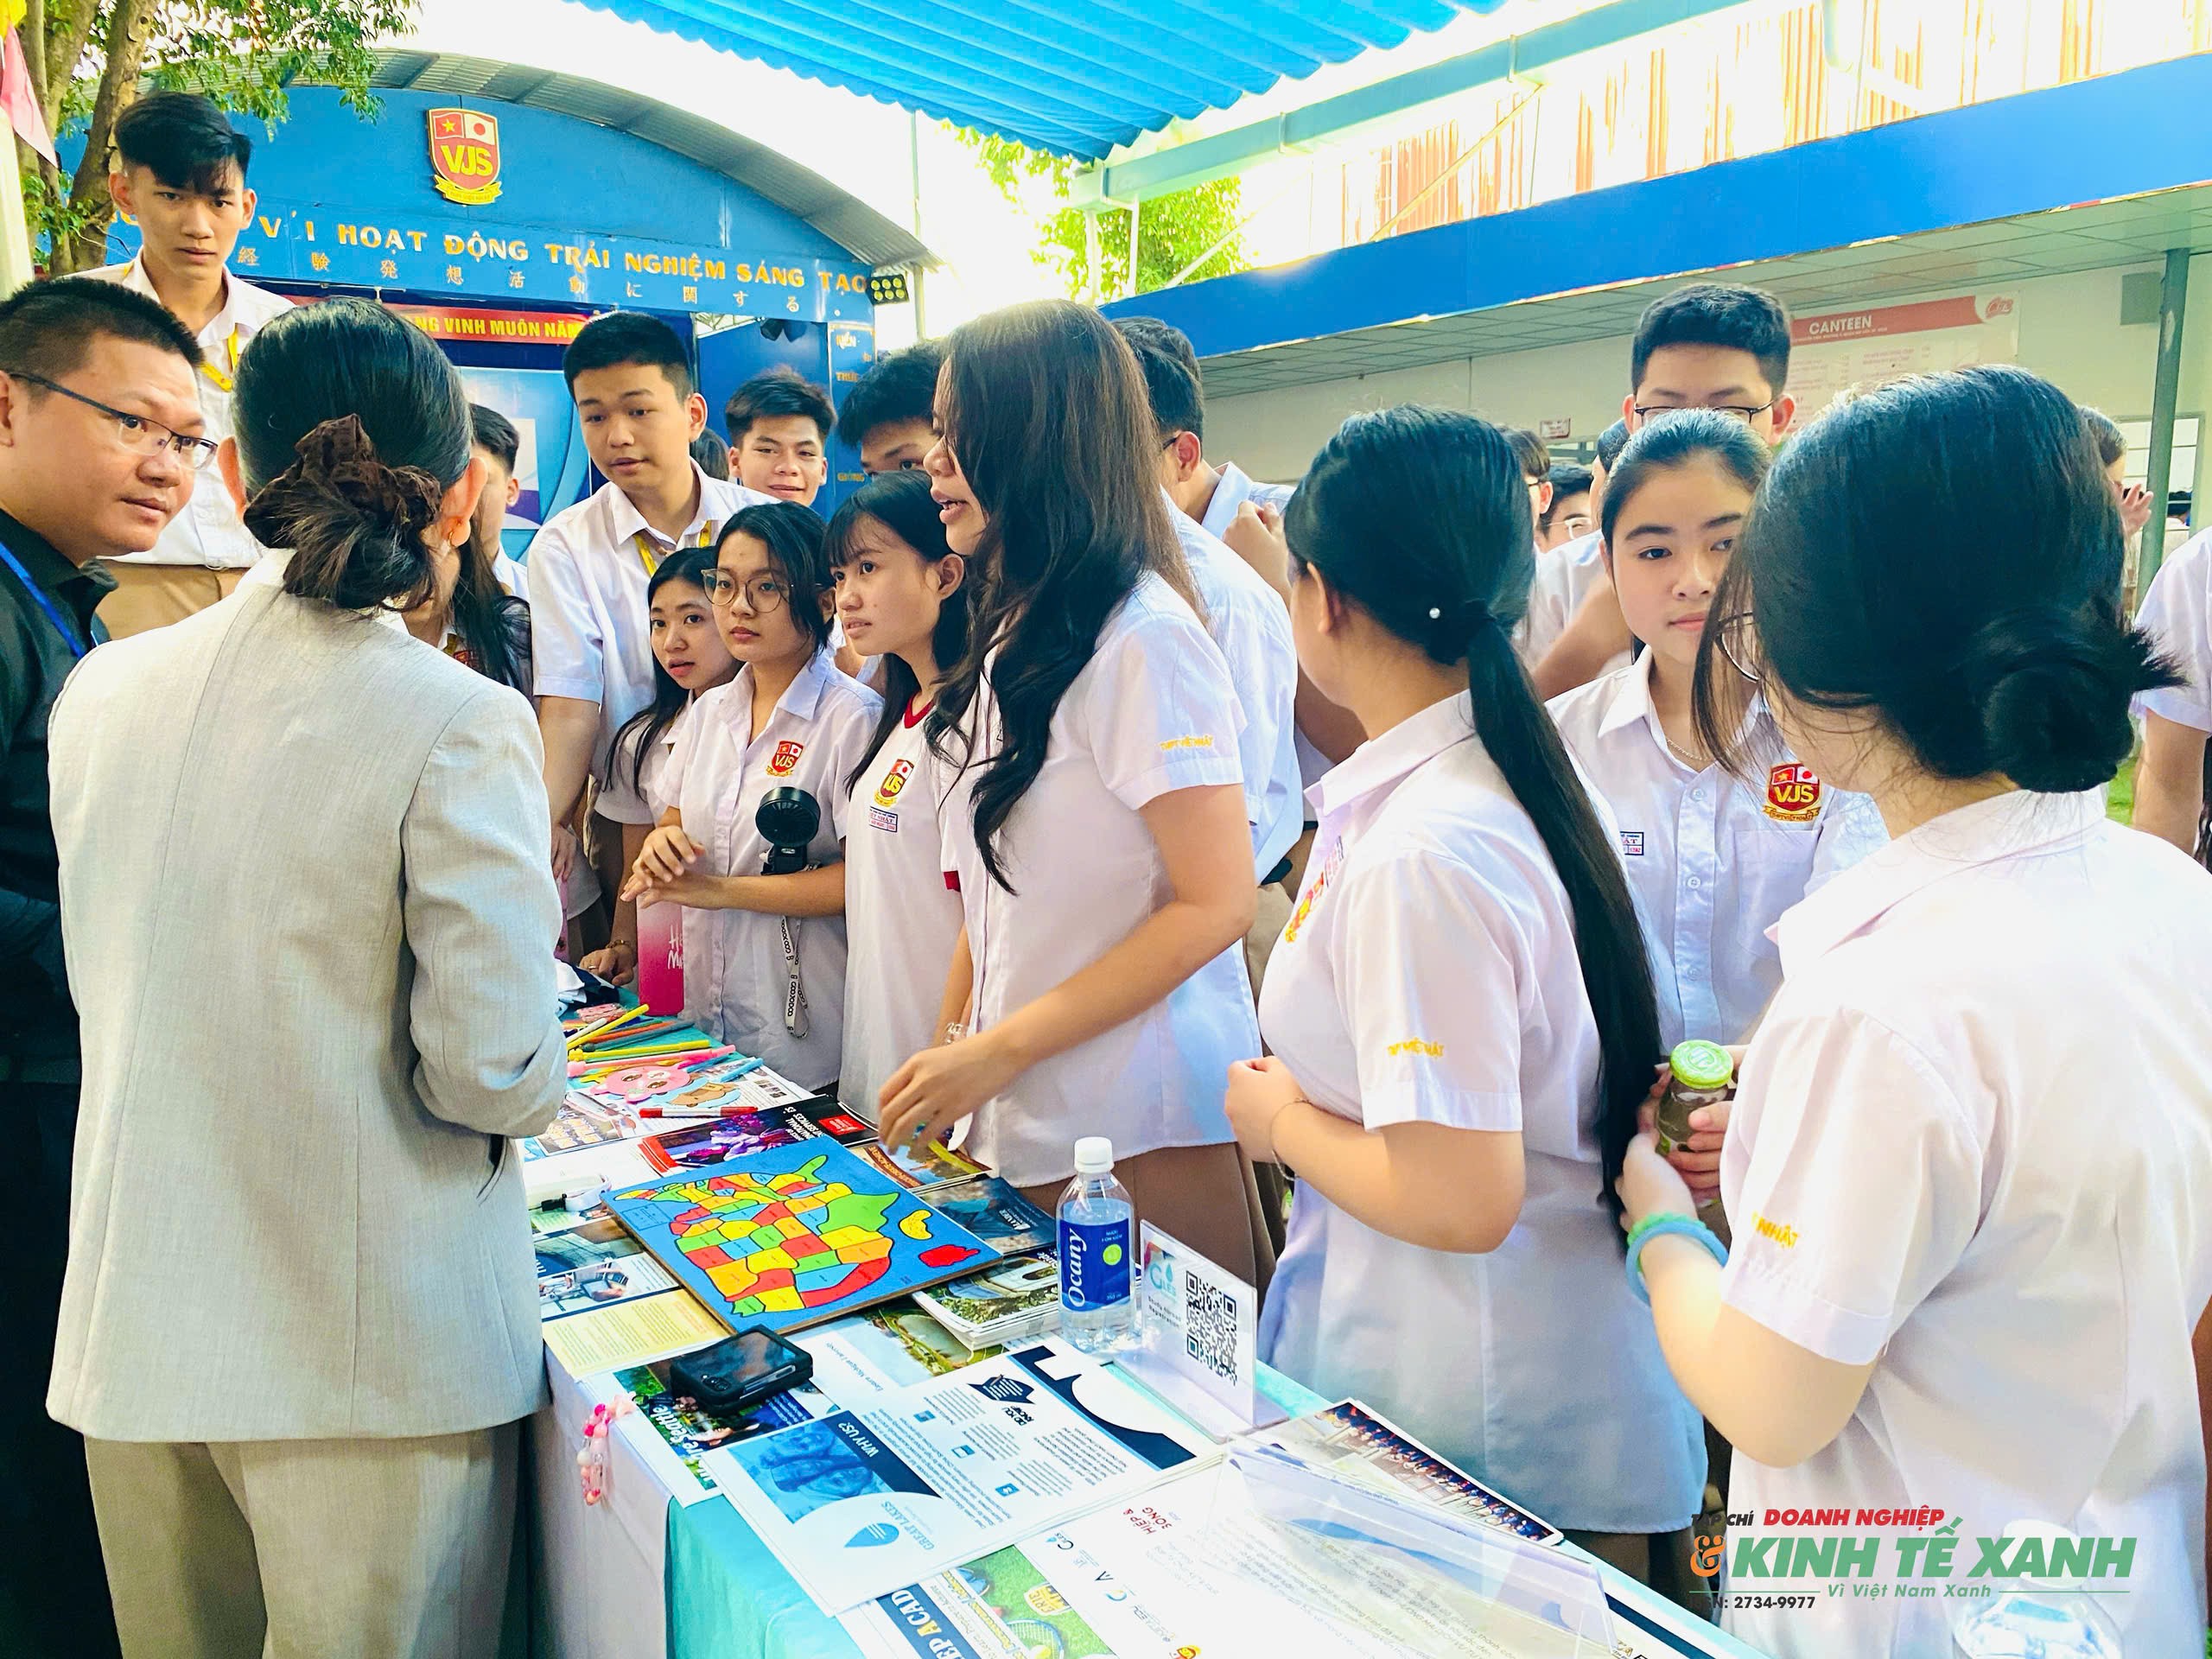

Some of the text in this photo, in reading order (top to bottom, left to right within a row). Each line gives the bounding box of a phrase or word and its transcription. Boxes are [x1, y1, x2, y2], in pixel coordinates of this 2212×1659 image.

[440, 144, 493, 176] VJS
[338, 224, 868, 296] HOẠT ĐỘNG TRẢI NGHIỆM SÁNG TẠO
[444, 316, 486, 334] VINH
[490, 319, 540, 338] MUÔN
[1808, 315, 1872, 336] CANTEEN
[775, 754, 795, 768] VJS
[1773, 784, 1815, 803] VJS
[1068, 1228, 1088, 1307] Ocany
[653, 1404, 691, 1444] Seattle
[1000, 1407, 1027, 1426] DID YOU
[836, 1420, 881, 1457] WHY US?
[878, 1500, 910, 1525] LAKES
[902, 1523, 936, 1550] GREAT
[891, 1589, 943, 1637] ACAD
